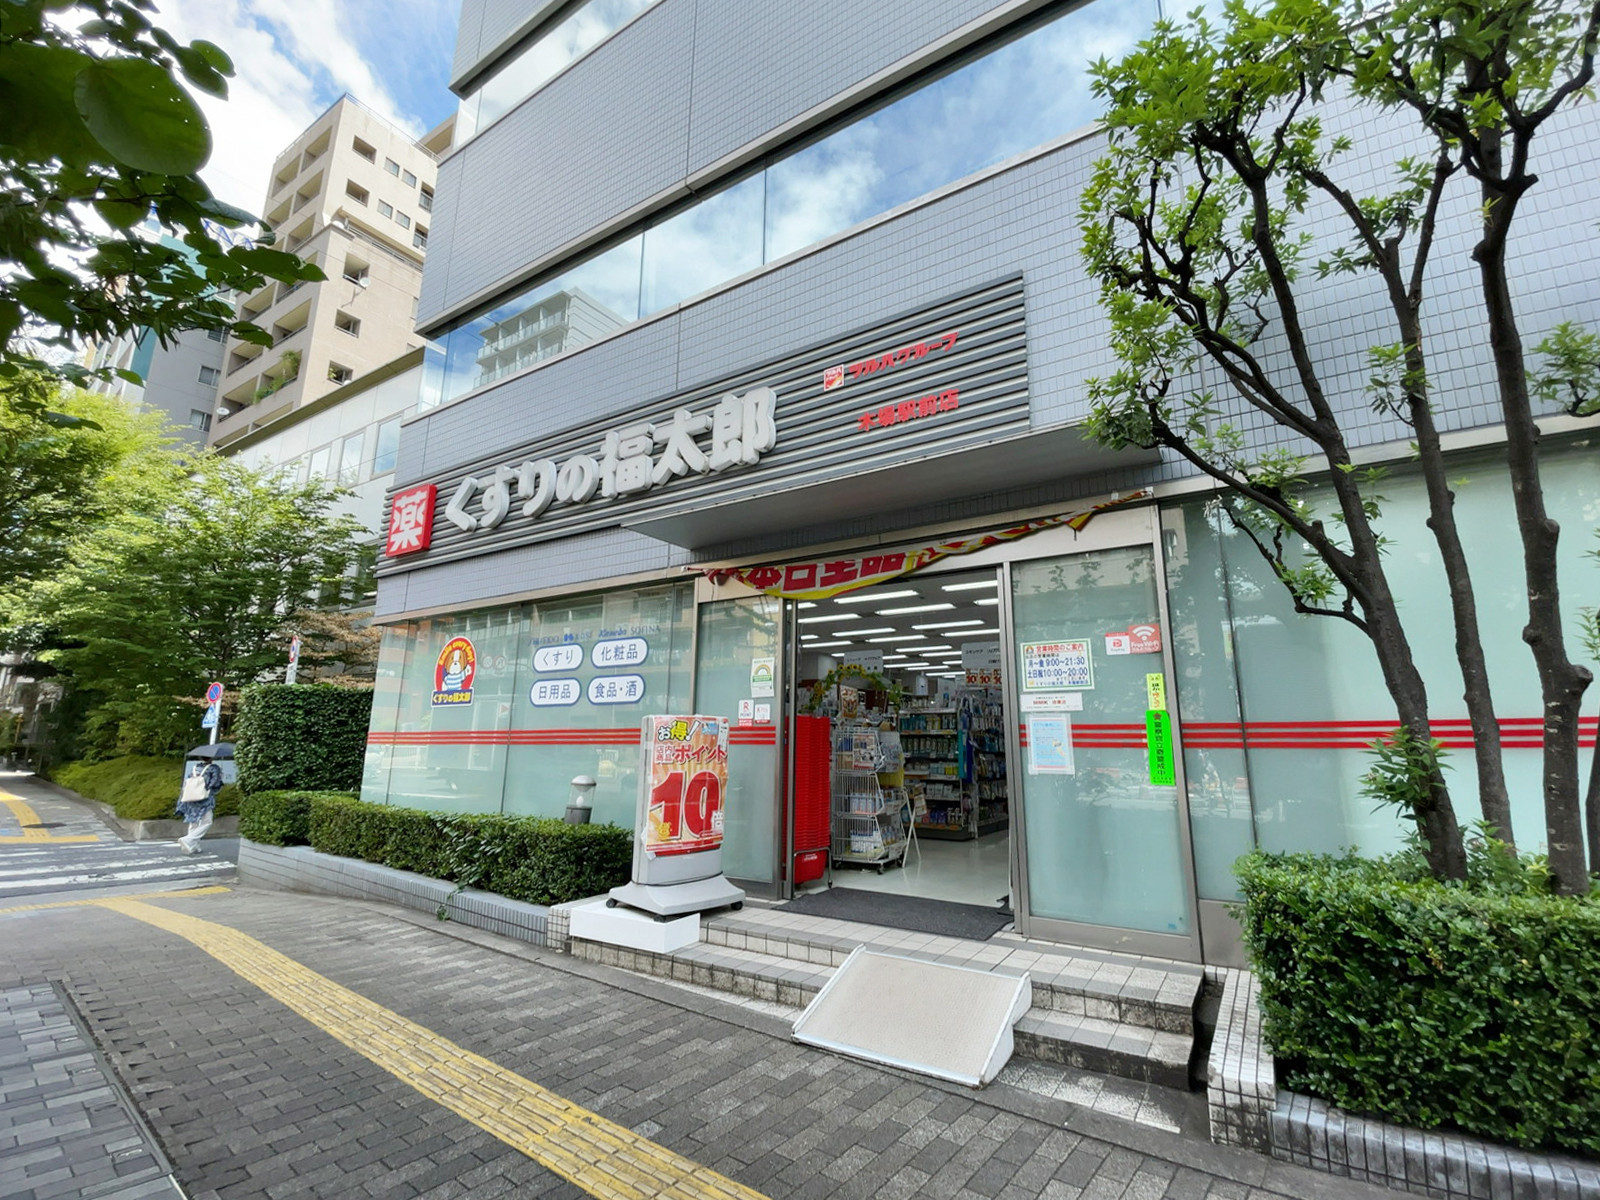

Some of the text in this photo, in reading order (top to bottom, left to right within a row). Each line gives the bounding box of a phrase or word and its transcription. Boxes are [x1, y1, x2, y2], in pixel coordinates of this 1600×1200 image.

[858, 389, 959, 431] 木場駅前店
[444, 386, 777, 532] くすりの福太郎
[388, 490, 428, 554] 薬
[631, 624, 661, 635] SOFINA
[543, 650, 573, 665] くすり
[601, 643, 638, 661] 化粧品
[1036, 644, 1084, 653] 営業時間のご案内
[538, 684, 571, 699] 日用品
[594, 681, 637, 698] 食品・酒
[743, 701, 750, 711] R
[658, 720, 701, 741] お得!
[674, 744, 728, 763] ポイント
[650, 770, 721, 838] 10
